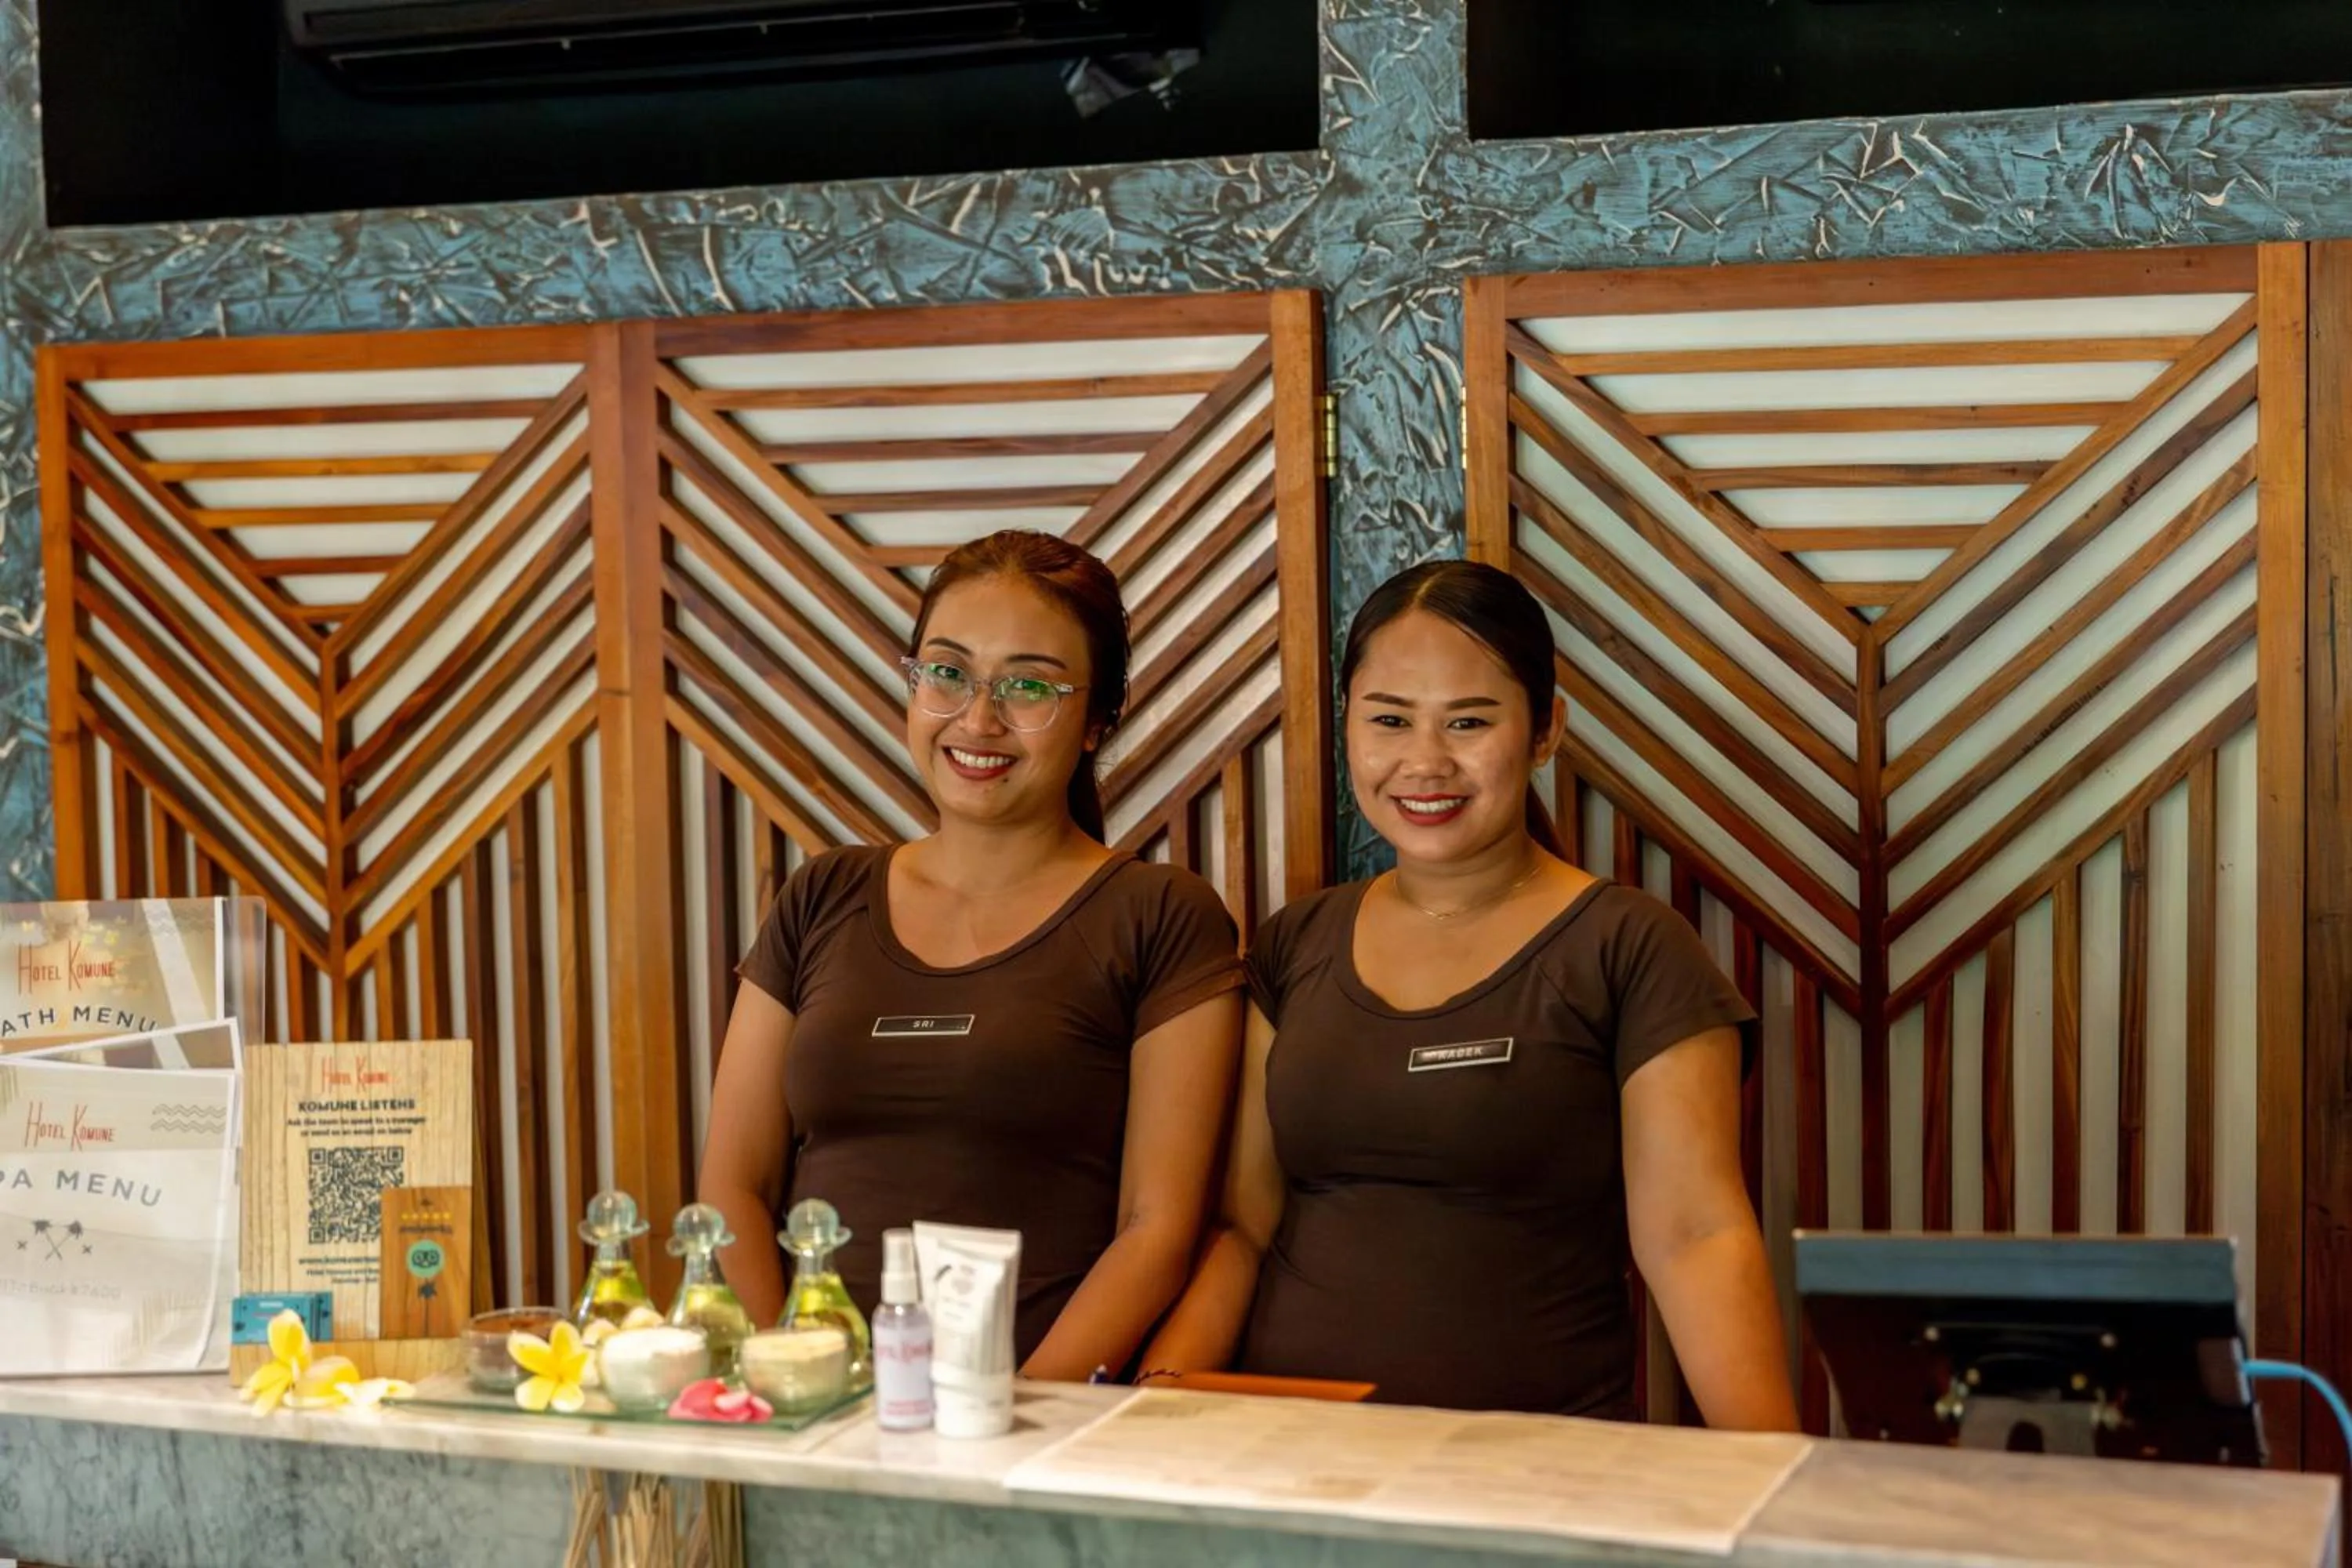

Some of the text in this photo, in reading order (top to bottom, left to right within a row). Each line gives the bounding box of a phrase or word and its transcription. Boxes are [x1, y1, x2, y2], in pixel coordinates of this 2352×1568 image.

[1, 1006, 157, 1036] ATH MENU
[299, 1100, 357, 1112] KOMUNE
[56, 1170, 162, 1207] MENU
